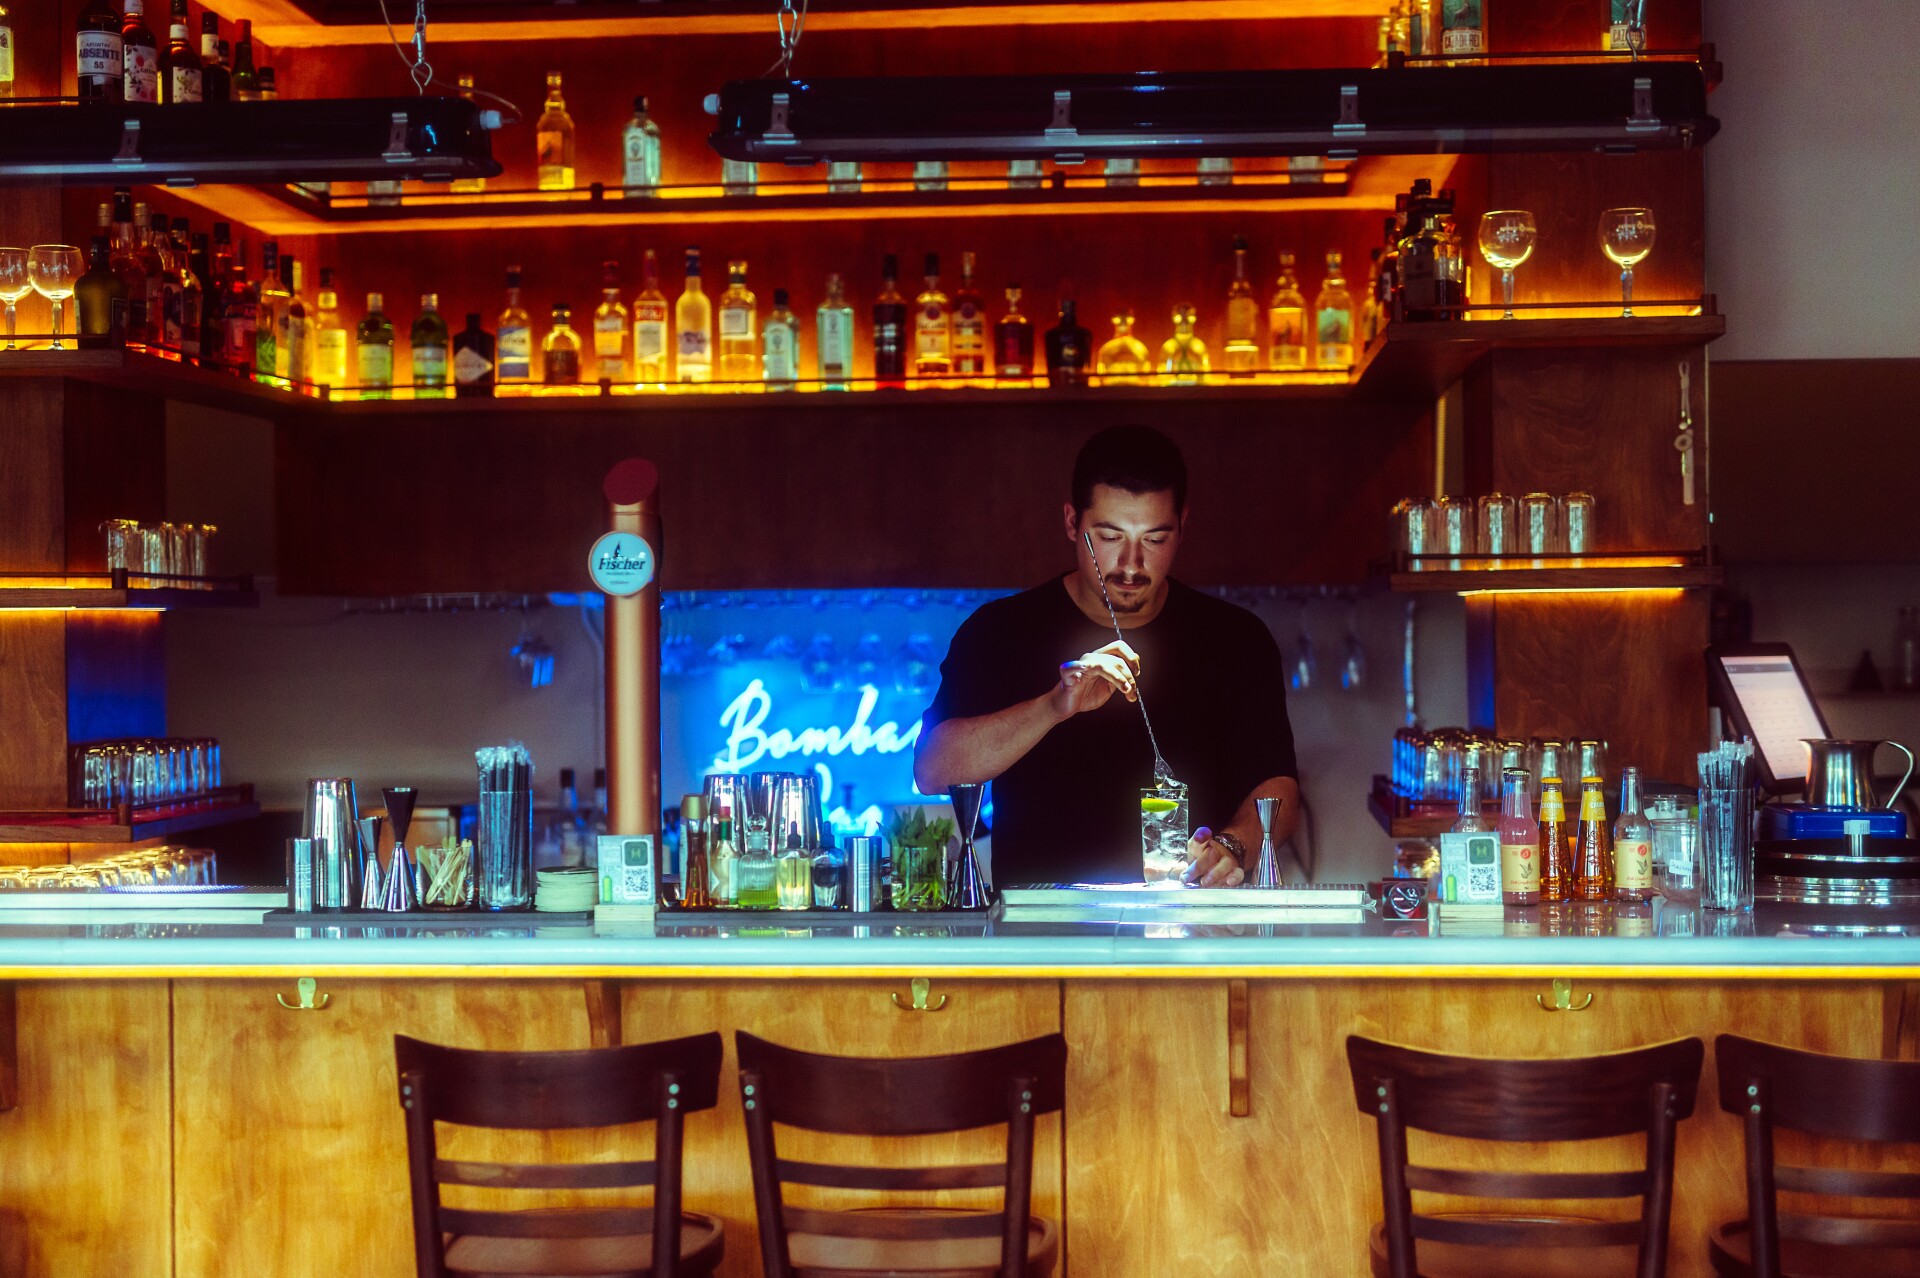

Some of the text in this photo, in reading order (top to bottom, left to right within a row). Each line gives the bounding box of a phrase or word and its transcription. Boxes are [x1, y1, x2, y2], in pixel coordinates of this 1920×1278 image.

[79, 48, 120, 60] ABSENTE
[94, 61, 104, 70] 55
[598, 557, 645, 570] Fischer
